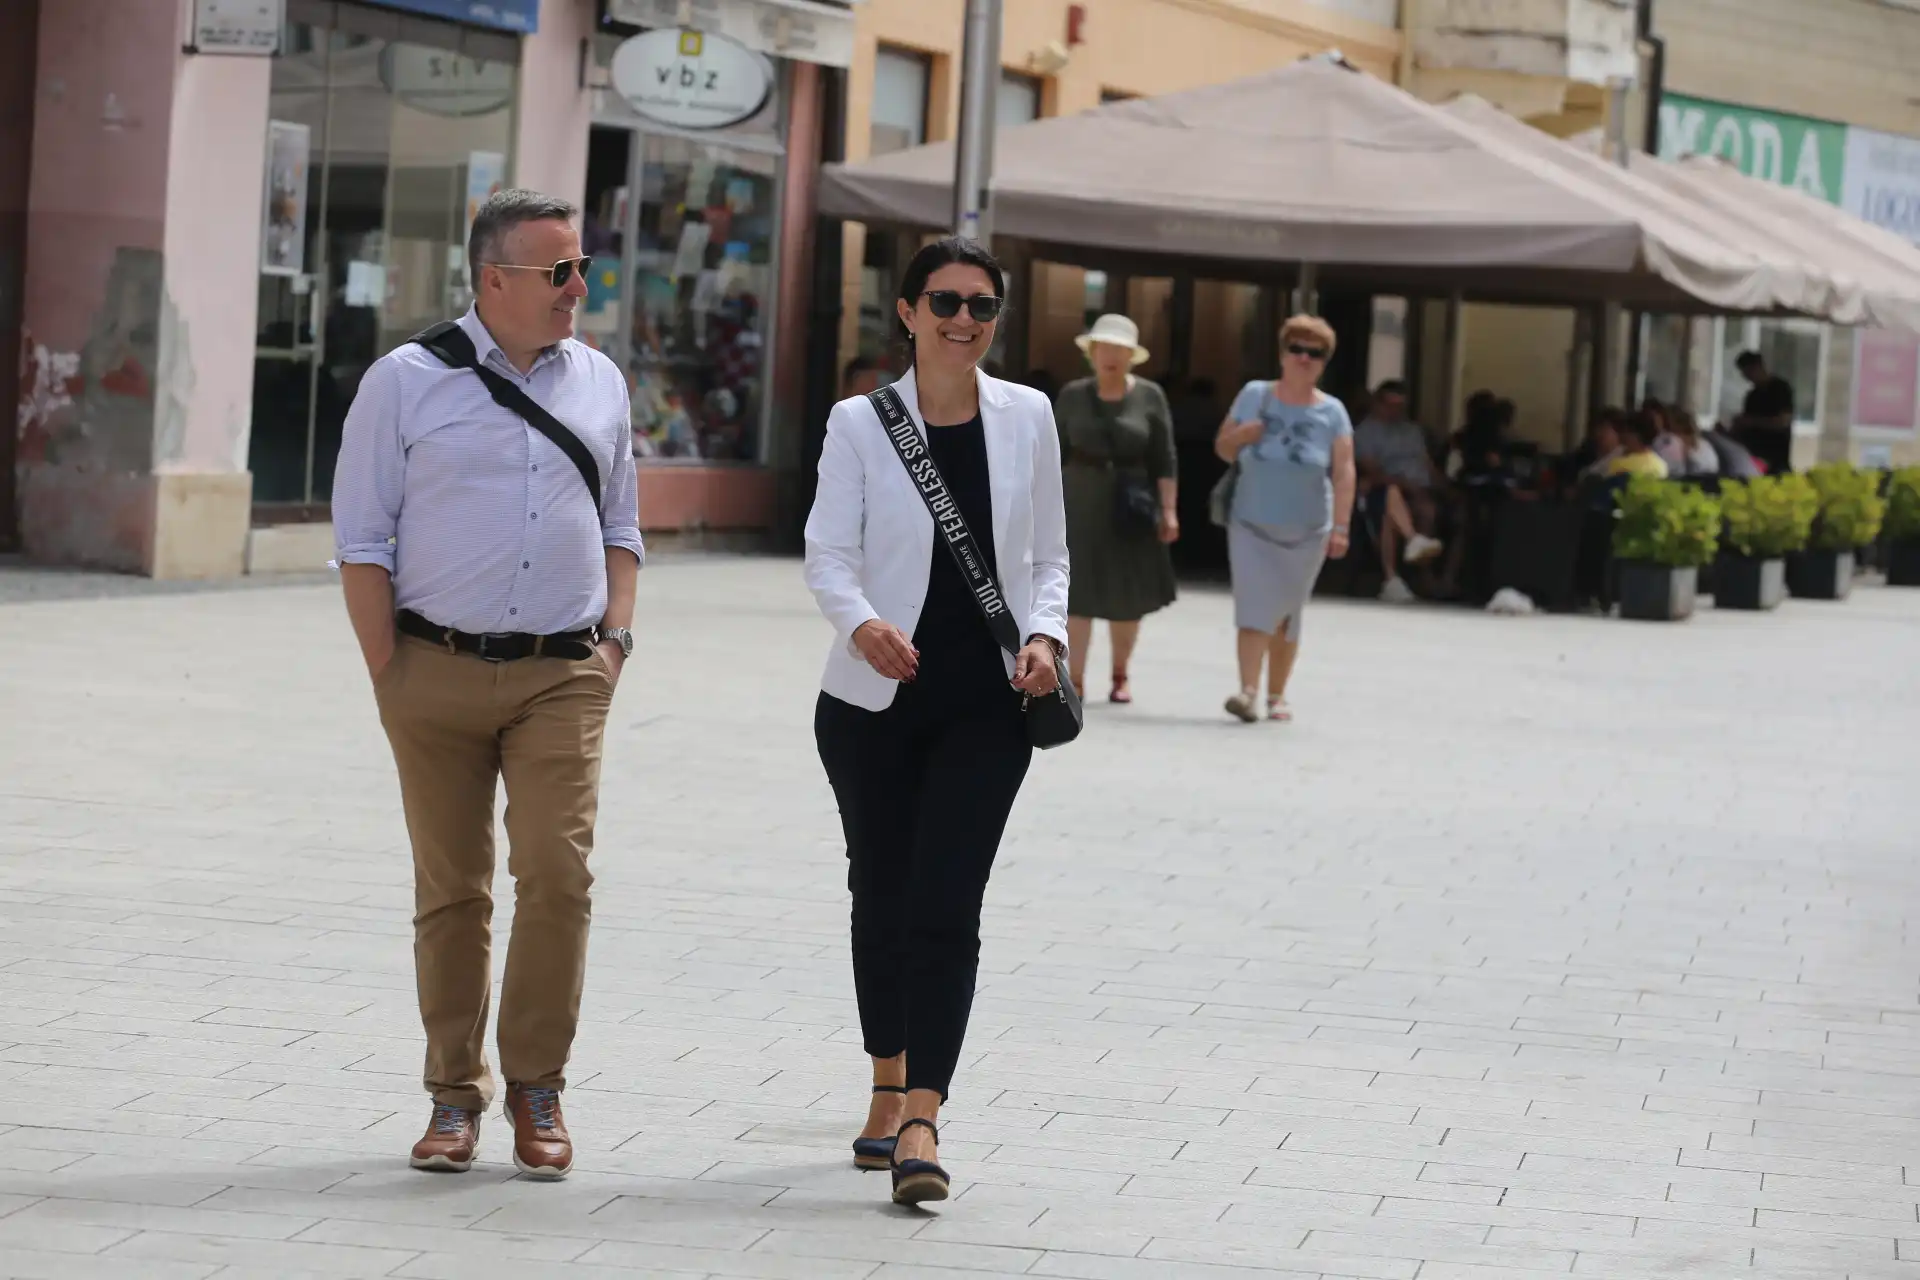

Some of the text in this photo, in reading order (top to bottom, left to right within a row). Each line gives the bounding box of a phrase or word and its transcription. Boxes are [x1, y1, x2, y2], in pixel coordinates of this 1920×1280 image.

[656, 64, 718, 90] vbz
[1658, 103, 1827, 197] MODA
[876, 392, 897, 419] BE BRAVE
[890, 416, 968, 543] FEARLESS SOUL
[959, 544, 981, 580] BE BRAVE
